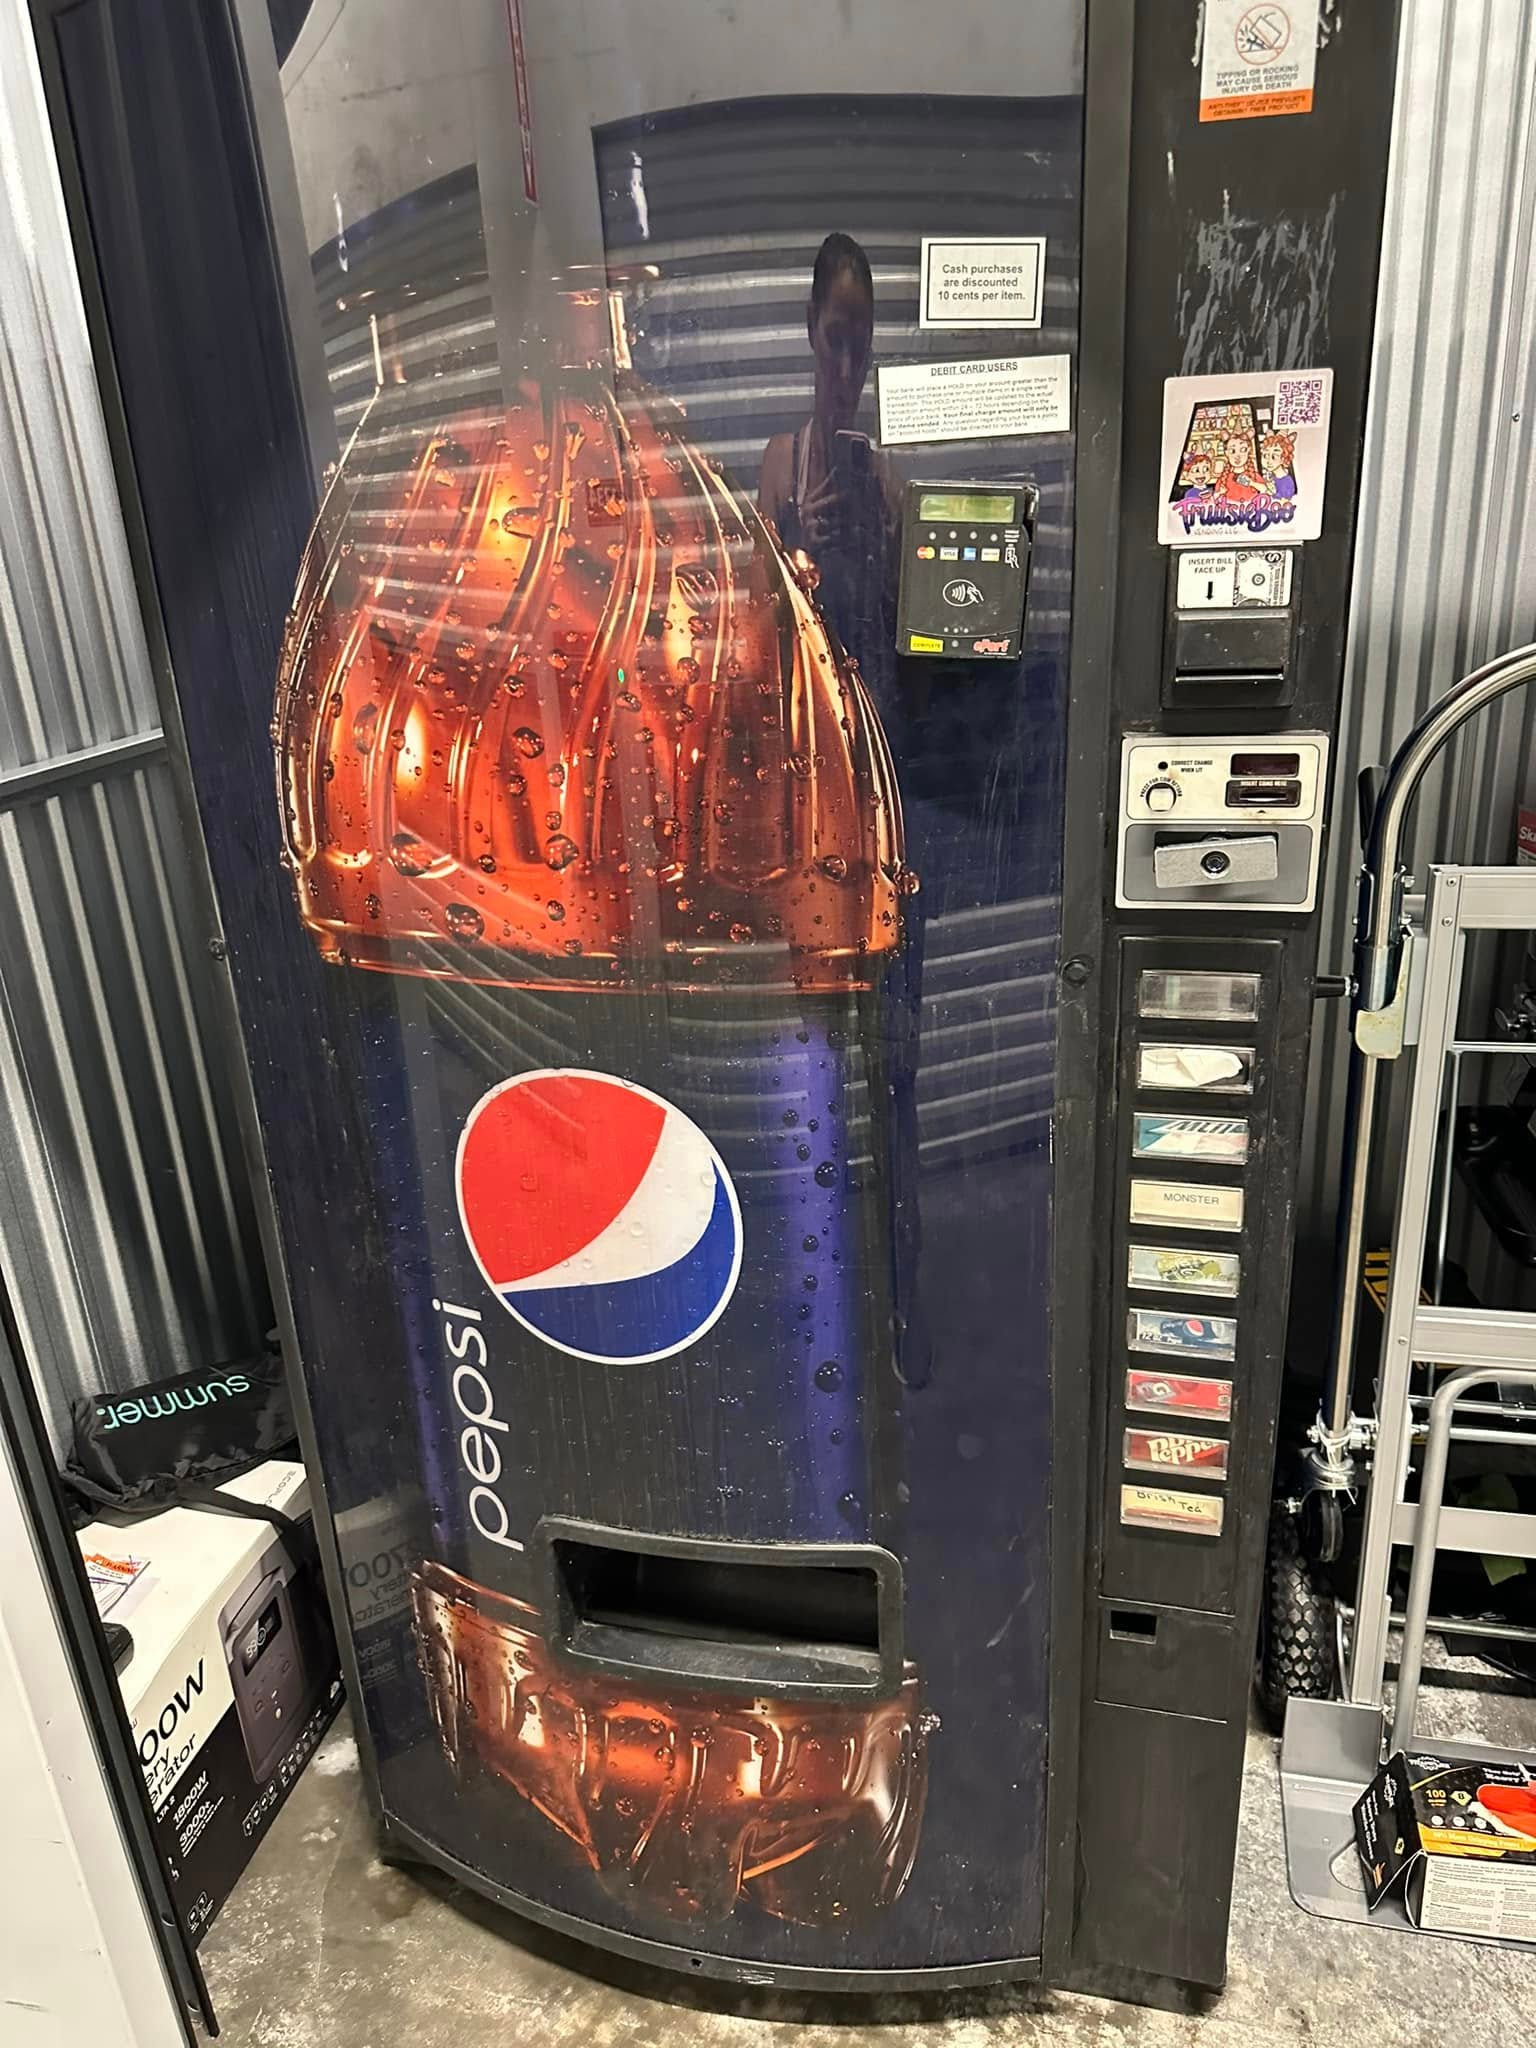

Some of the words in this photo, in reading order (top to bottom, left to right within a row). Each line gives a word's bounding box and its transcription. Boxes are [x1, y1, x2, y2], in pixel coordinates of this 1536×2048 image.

[1216, 70, 1247, 79] TIPPING
[1249, 68, 1261, 76] OR
[1262, 65, 1299, 75] ROCKING
[1216, 79, 1233, 87] MAY
[1235, 76, 1261, 85] CAUSE
[1263, 73, 1298, 82] SERIOUS
[1221, 86, 1250, 94] INJURY
[1265, 81, 1292, 90] DEATH
[942, 264, 968, 274] Cash
[971, 264, 1023, 276] purchases
[943, 279, 959, 287] are
[961, 277, 1018, 287] discounted
[938, 291, 949, 300] 10
[952, 291, 979, 300] cents
[982, 292, 999, 302] per
[1000, 290, 1026, 300] item.
[930, 365, 957, 377] DEBIT
[959, 363, 986, 375] CARD
[987, 361, 1018, 373] USERS
[1188, 557, 1216, 566] INSERT
[1216, 557, 1233, 565] BILL
[1194, 566, 1214, 574] FACE
[1163, 1193, 1220, 1205] MONSTER
[96, 1375, 250, 1430] summer.
[432, 1298, 524, 1553] pepsi
[1178, 1501, 1202, 1513] Tea
[173, 1770, 207, 1823] 1800W
[1425, 1789, 1446, 1799] 100
